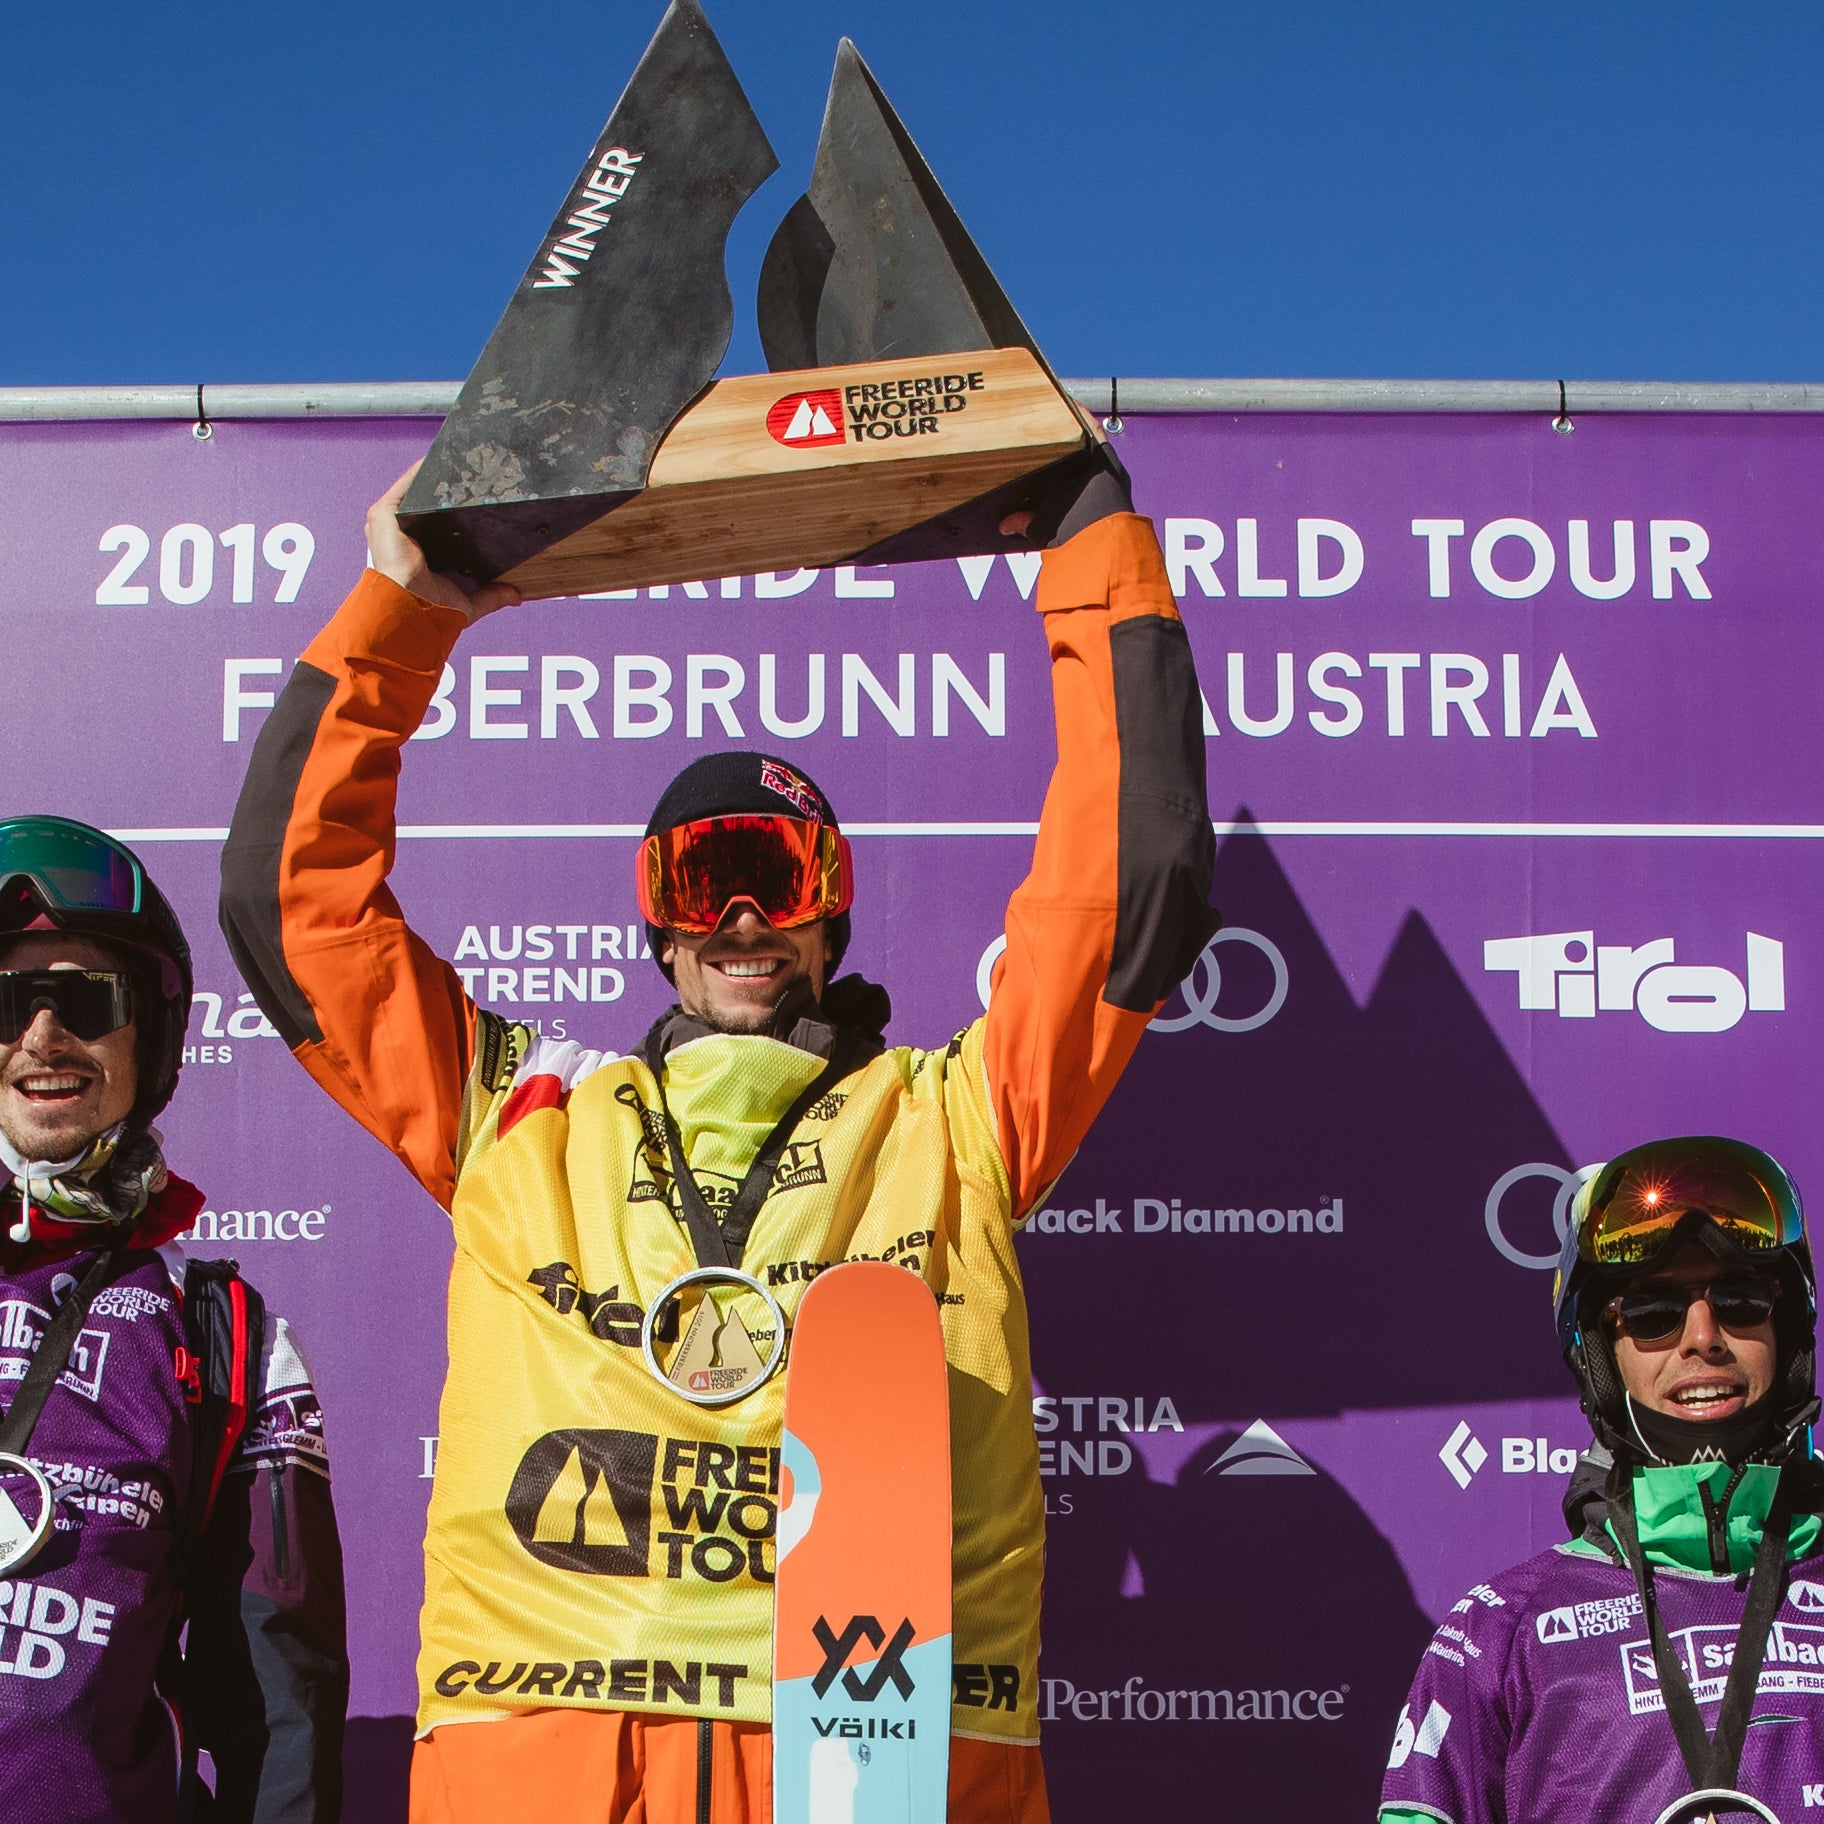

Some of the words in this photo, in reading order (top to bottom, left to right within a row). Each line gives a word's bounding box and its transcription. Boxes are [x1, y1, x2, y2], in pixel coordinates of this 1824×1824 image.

[532, 146, 645, 289] WINNER
[845, 371, 985, 403] FREERIDE
[847, 392, 967, 421] WORLD
[850, 415, 940, 442] TOUR
[96, 523, 314, 605] 2019
[1412, 518, 1712, 599] TOUR
[1483, 930, 1785, 1033] Tirol
[433, 1659, 749, 1709] CURRENT
